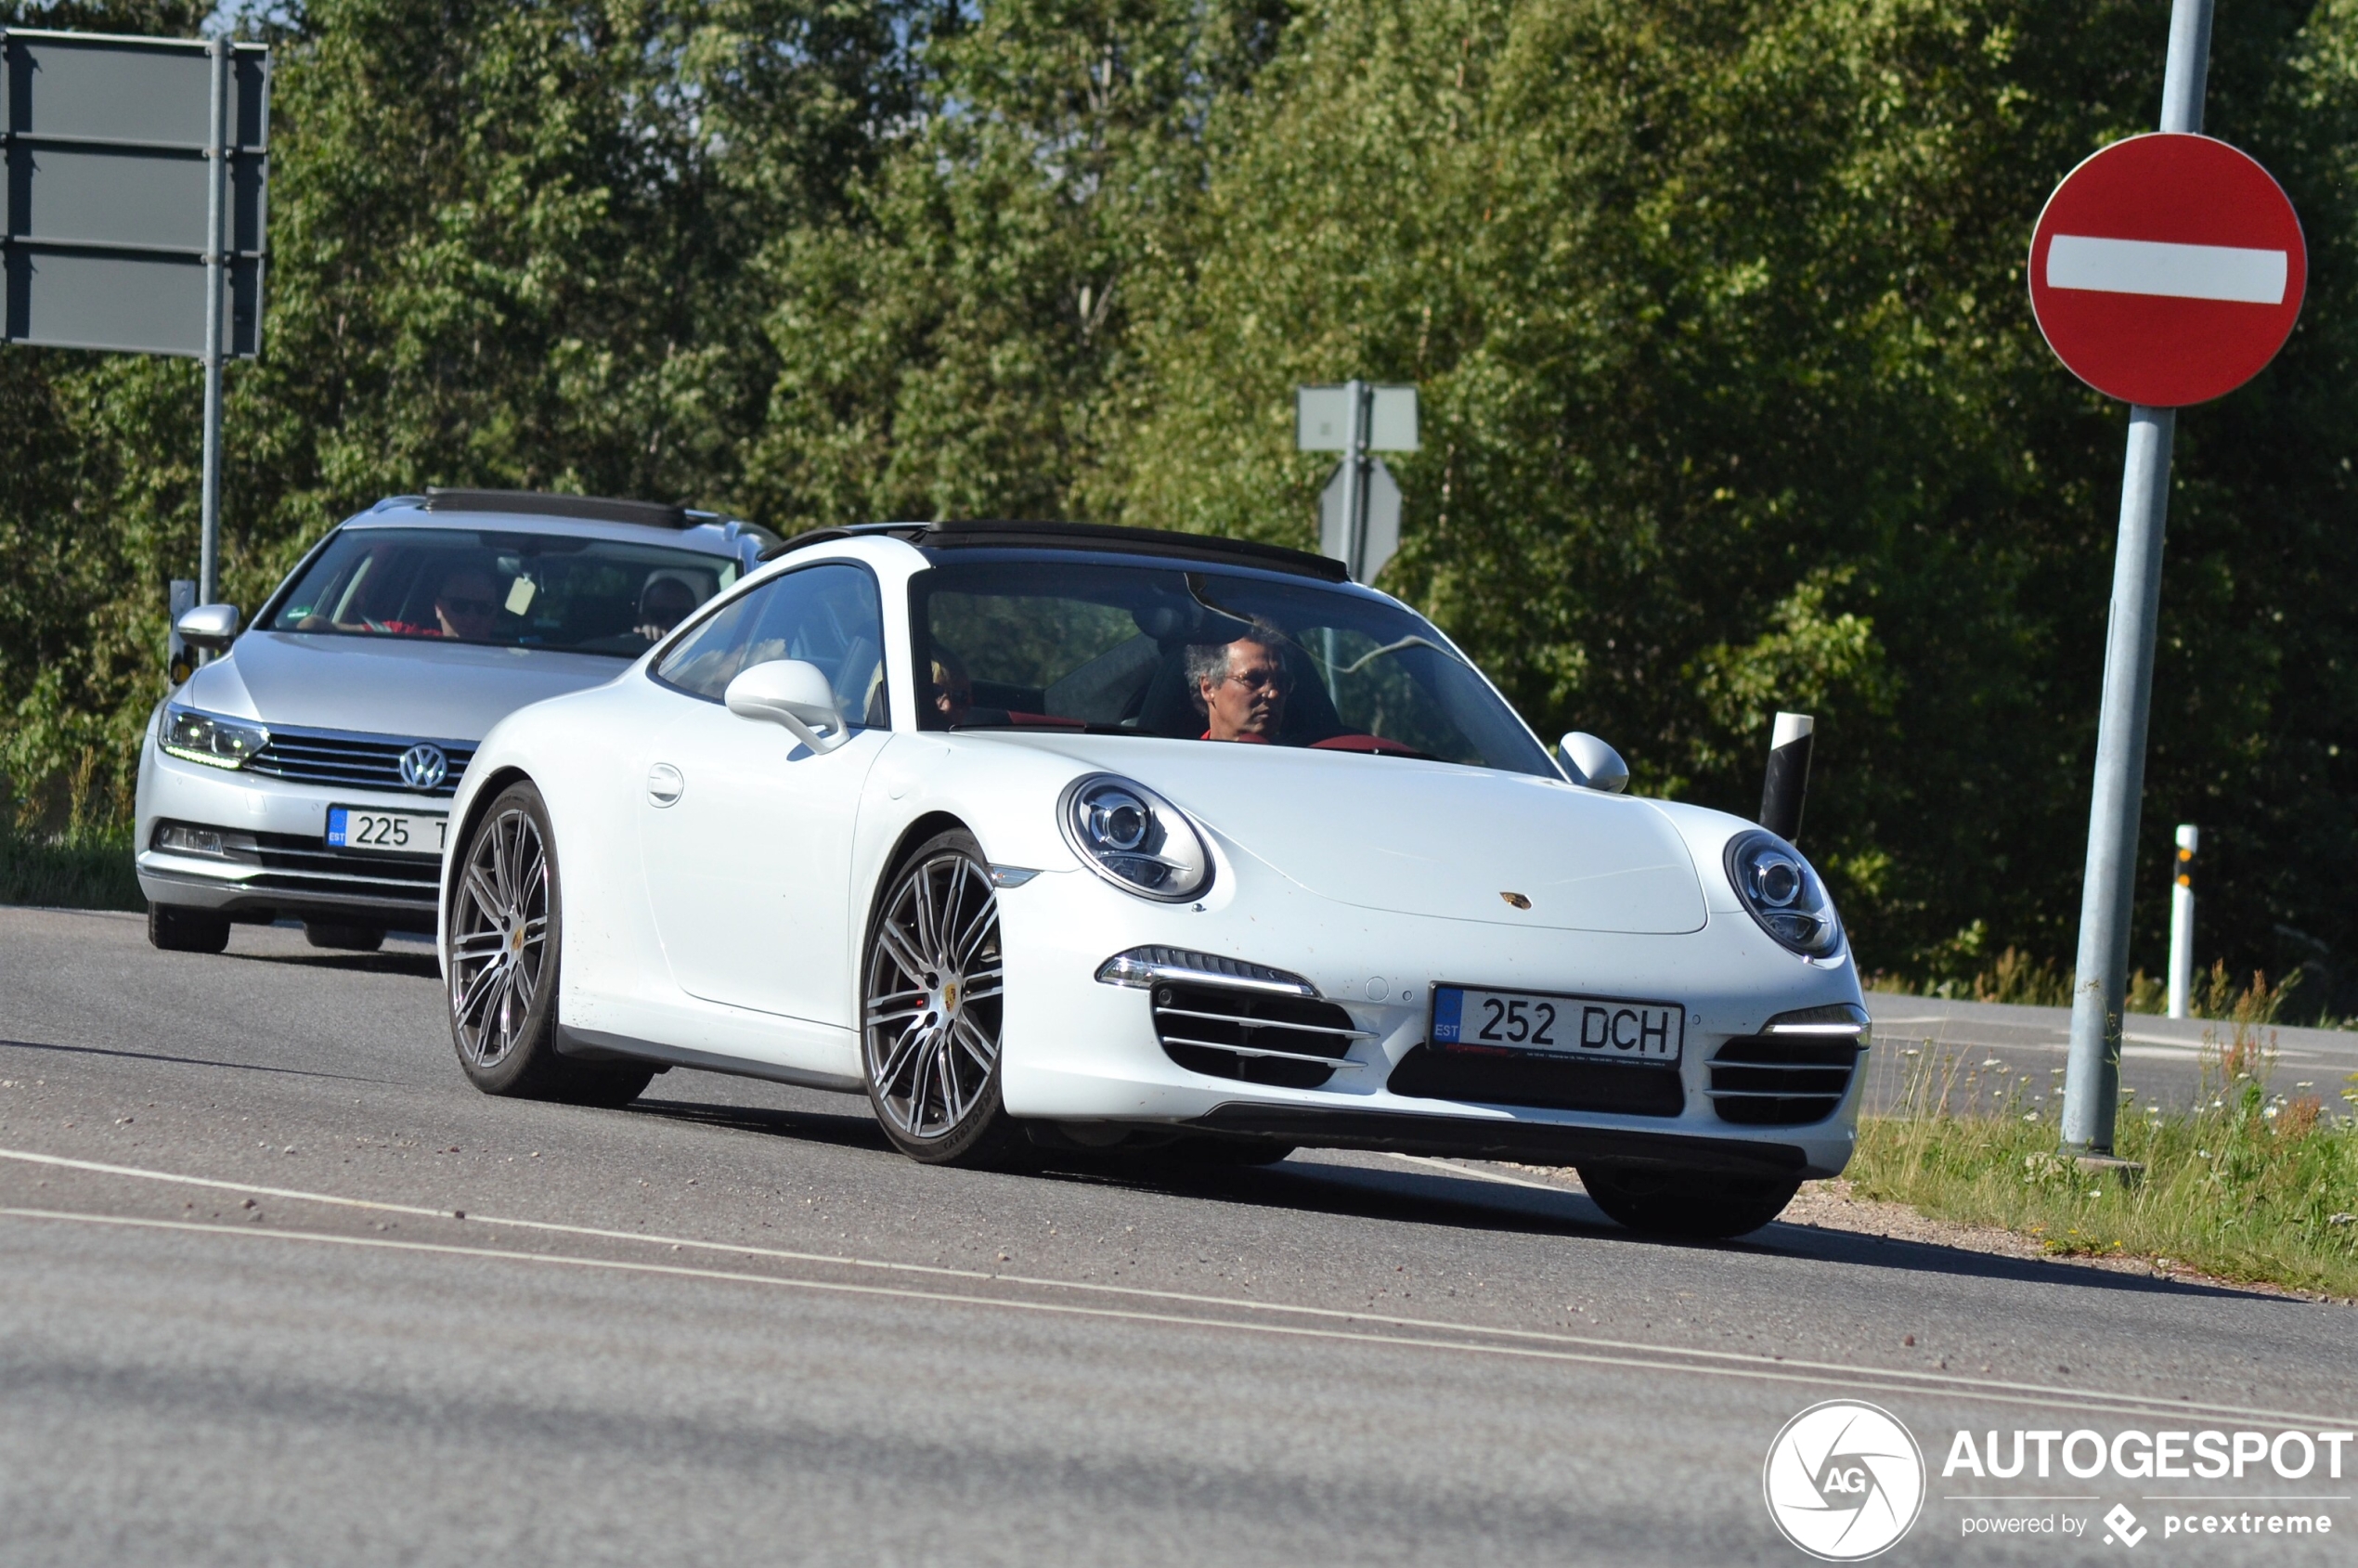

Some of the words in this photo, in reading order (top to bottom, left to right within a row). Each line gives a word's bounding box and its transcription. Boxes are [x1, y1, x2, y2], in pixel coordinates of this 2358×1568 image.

[329, 832, 345, 842] EST
[356, 816, 408, 846] 225
[1434, 1024, 1459, 1038] EST
[1479, 998, 1556, 1045] 252
[1580, 1005, 1669, 1054] DCH
